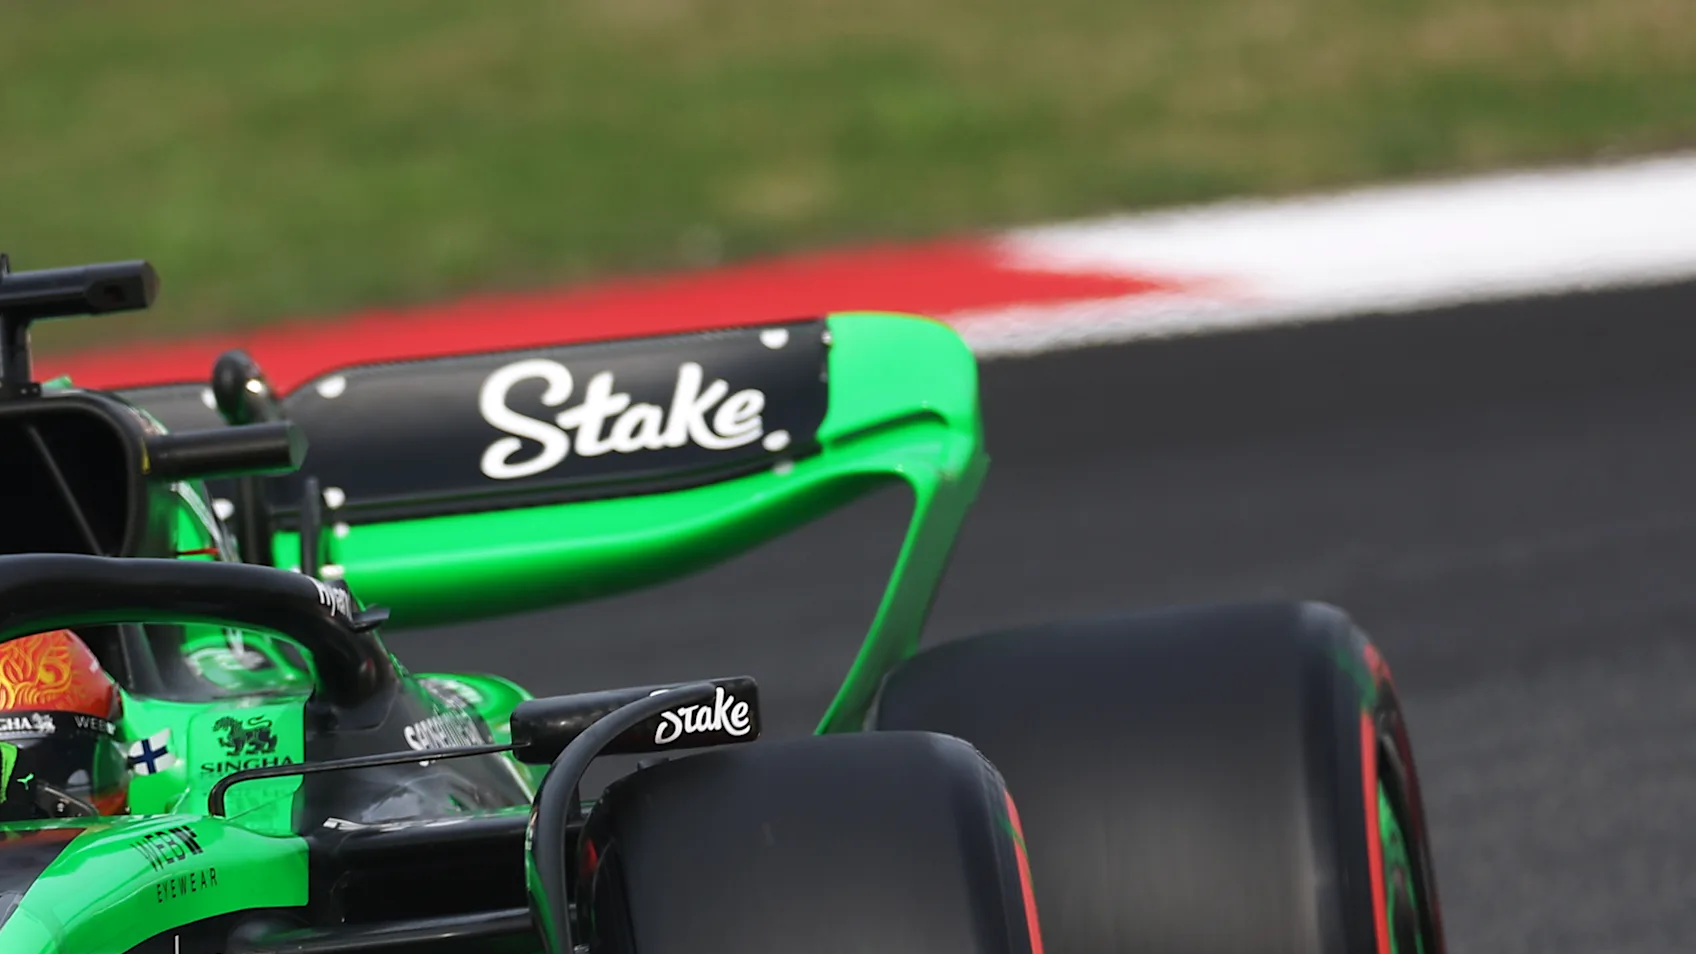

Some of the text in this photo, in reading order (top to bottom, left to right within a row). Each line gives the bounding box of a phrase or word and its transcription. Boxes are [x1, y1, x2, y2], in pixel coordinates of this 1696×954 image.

[480, 359, 765, 479] Stake
[654, 686, 752, 745] Stake
[156, 867, 218, 903] EYEWEAR
